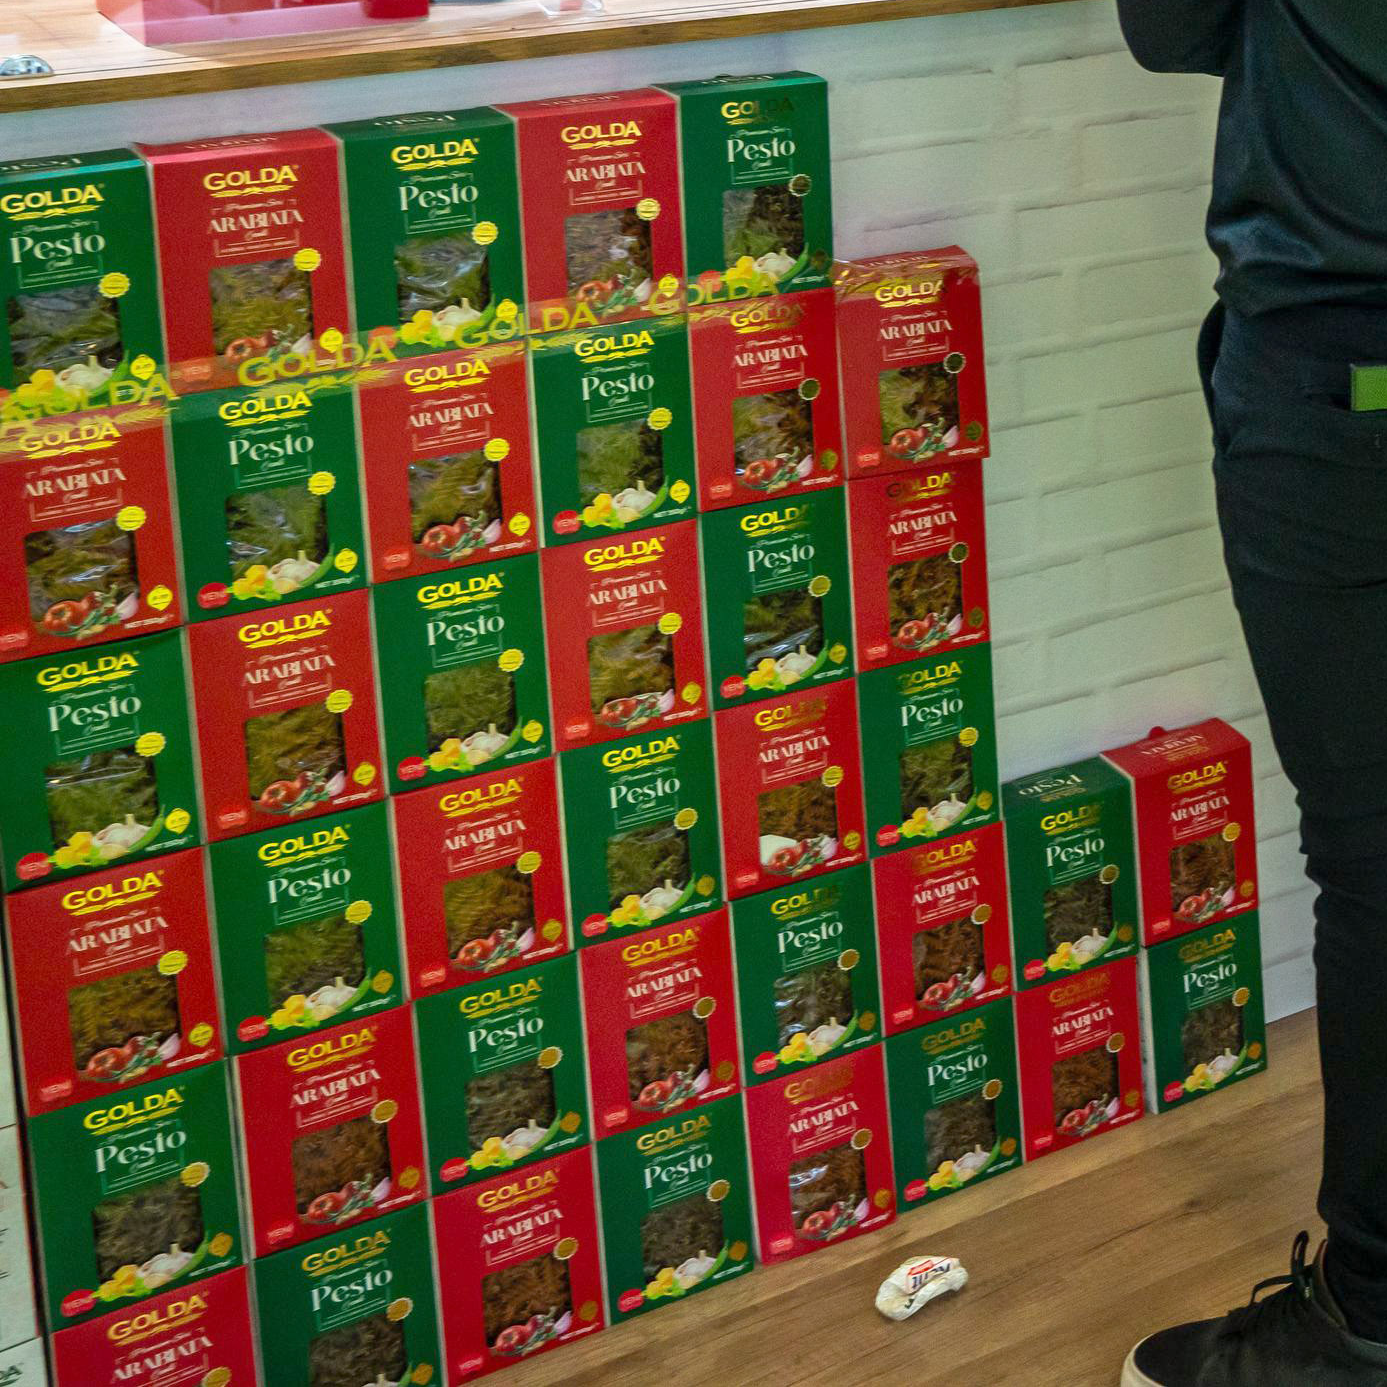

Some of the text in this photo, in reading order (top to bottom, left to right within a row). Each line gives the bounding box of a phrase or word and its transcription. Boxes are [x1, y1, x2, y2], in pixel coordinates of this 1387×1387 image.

[561, 121, 642, 143] GOLDA
[392, 139, 480, 164] GOLDA
[727, 137, 795, 163] Pesto
[204, 165, 299, 191] GOLDA
[565, 161, 646, 183] ARABIATA
[1, 184, 104, 213] GOLDA
[400, 182, 478, 211] Pesto
[208, 209, 304, 234] ARABIATA
[11, 232, 105, 264] Pesto
[574, 331, 655, 357] GOLDA
[878, 320, 953, 341] ARABIATA
[237, 334, 397, 386] GOLDA
[733, 344, 808, 367] ARABIATA
[404, 359, 491, 386] GOLDA
[581, 371, 654, 401] Pesto
[218, 390, 312, 421] GOLDA
[408, 402, 494, 429] ARABIATA
[18, 422, 121, 452] GOLDA
[229, 435, 314, 465] Pesto
[23, 467, 127, 497] ARABIATA
[888, 512, 957, 535] ARABIATA
[584, 537, 665, 566] GOLDA
[748, 544, 815, 572] Pesto
[417, 573, 504, 604] GOLDA
[588, 579, 667, 605] ARABIATA
[238, 611, 331, 643] GOLDA
[427, 614, 505, 646] Pesto
[37, 652, 139, 687] GOLDA
[244, 654, 336, 684] ARABIATA
[49, 695, 142, 732] Pesto
[754, 701, 827, 726] GOL
[902, 697, 963, 727] Pesto
[602, 736, 681, 768] GOLDA
[758, 735, 831, 763] ARABIATA
[1168, 761, 1228, 789] GOLDA
[439, 778, 523, 812] GOLDA
[609, 777, 681, 809] Pesto
[258, 826, 350, 861] GOLDA
[442, 819, 527, 851] ARABIATA
[1045, 836, 1105, 867] Pesto
[61, 871, 163, 911] GOLDA
[268, 867, 351, 904] Pesto
[67, 915, 169, 954] ARABIATA
[622, 928, 700, 962] GOLDA
[777, 919, 843, 953] Pesto
[626, 966, 702, 999] ARABIATA
[1183, 960, 1237, 994] Pesto
[459, 978, 543, 1014] GOLDA
[287, 1028, 377, 1067] GOLDA
[468, 1016, 544, 1053] Pesto
[928, 1052, 988, 1087] Pesto
[290, 1068, 381, 1107] ARABIATA
[84, 1088, 184, 1130] GOLDA
[636, 1115, 711, 1151] GOLDA
[95, 1130, 186, 1173] Pesto
[644, 1152, 713, 1189] Pesto
[477, 1170, 559, 1208] GOLDA
[302, 1230, 391, 1272] GOLDA
[310, 1269, 393, 1312] Pesto
[107, 1294, 208, 1340] GOLDA
